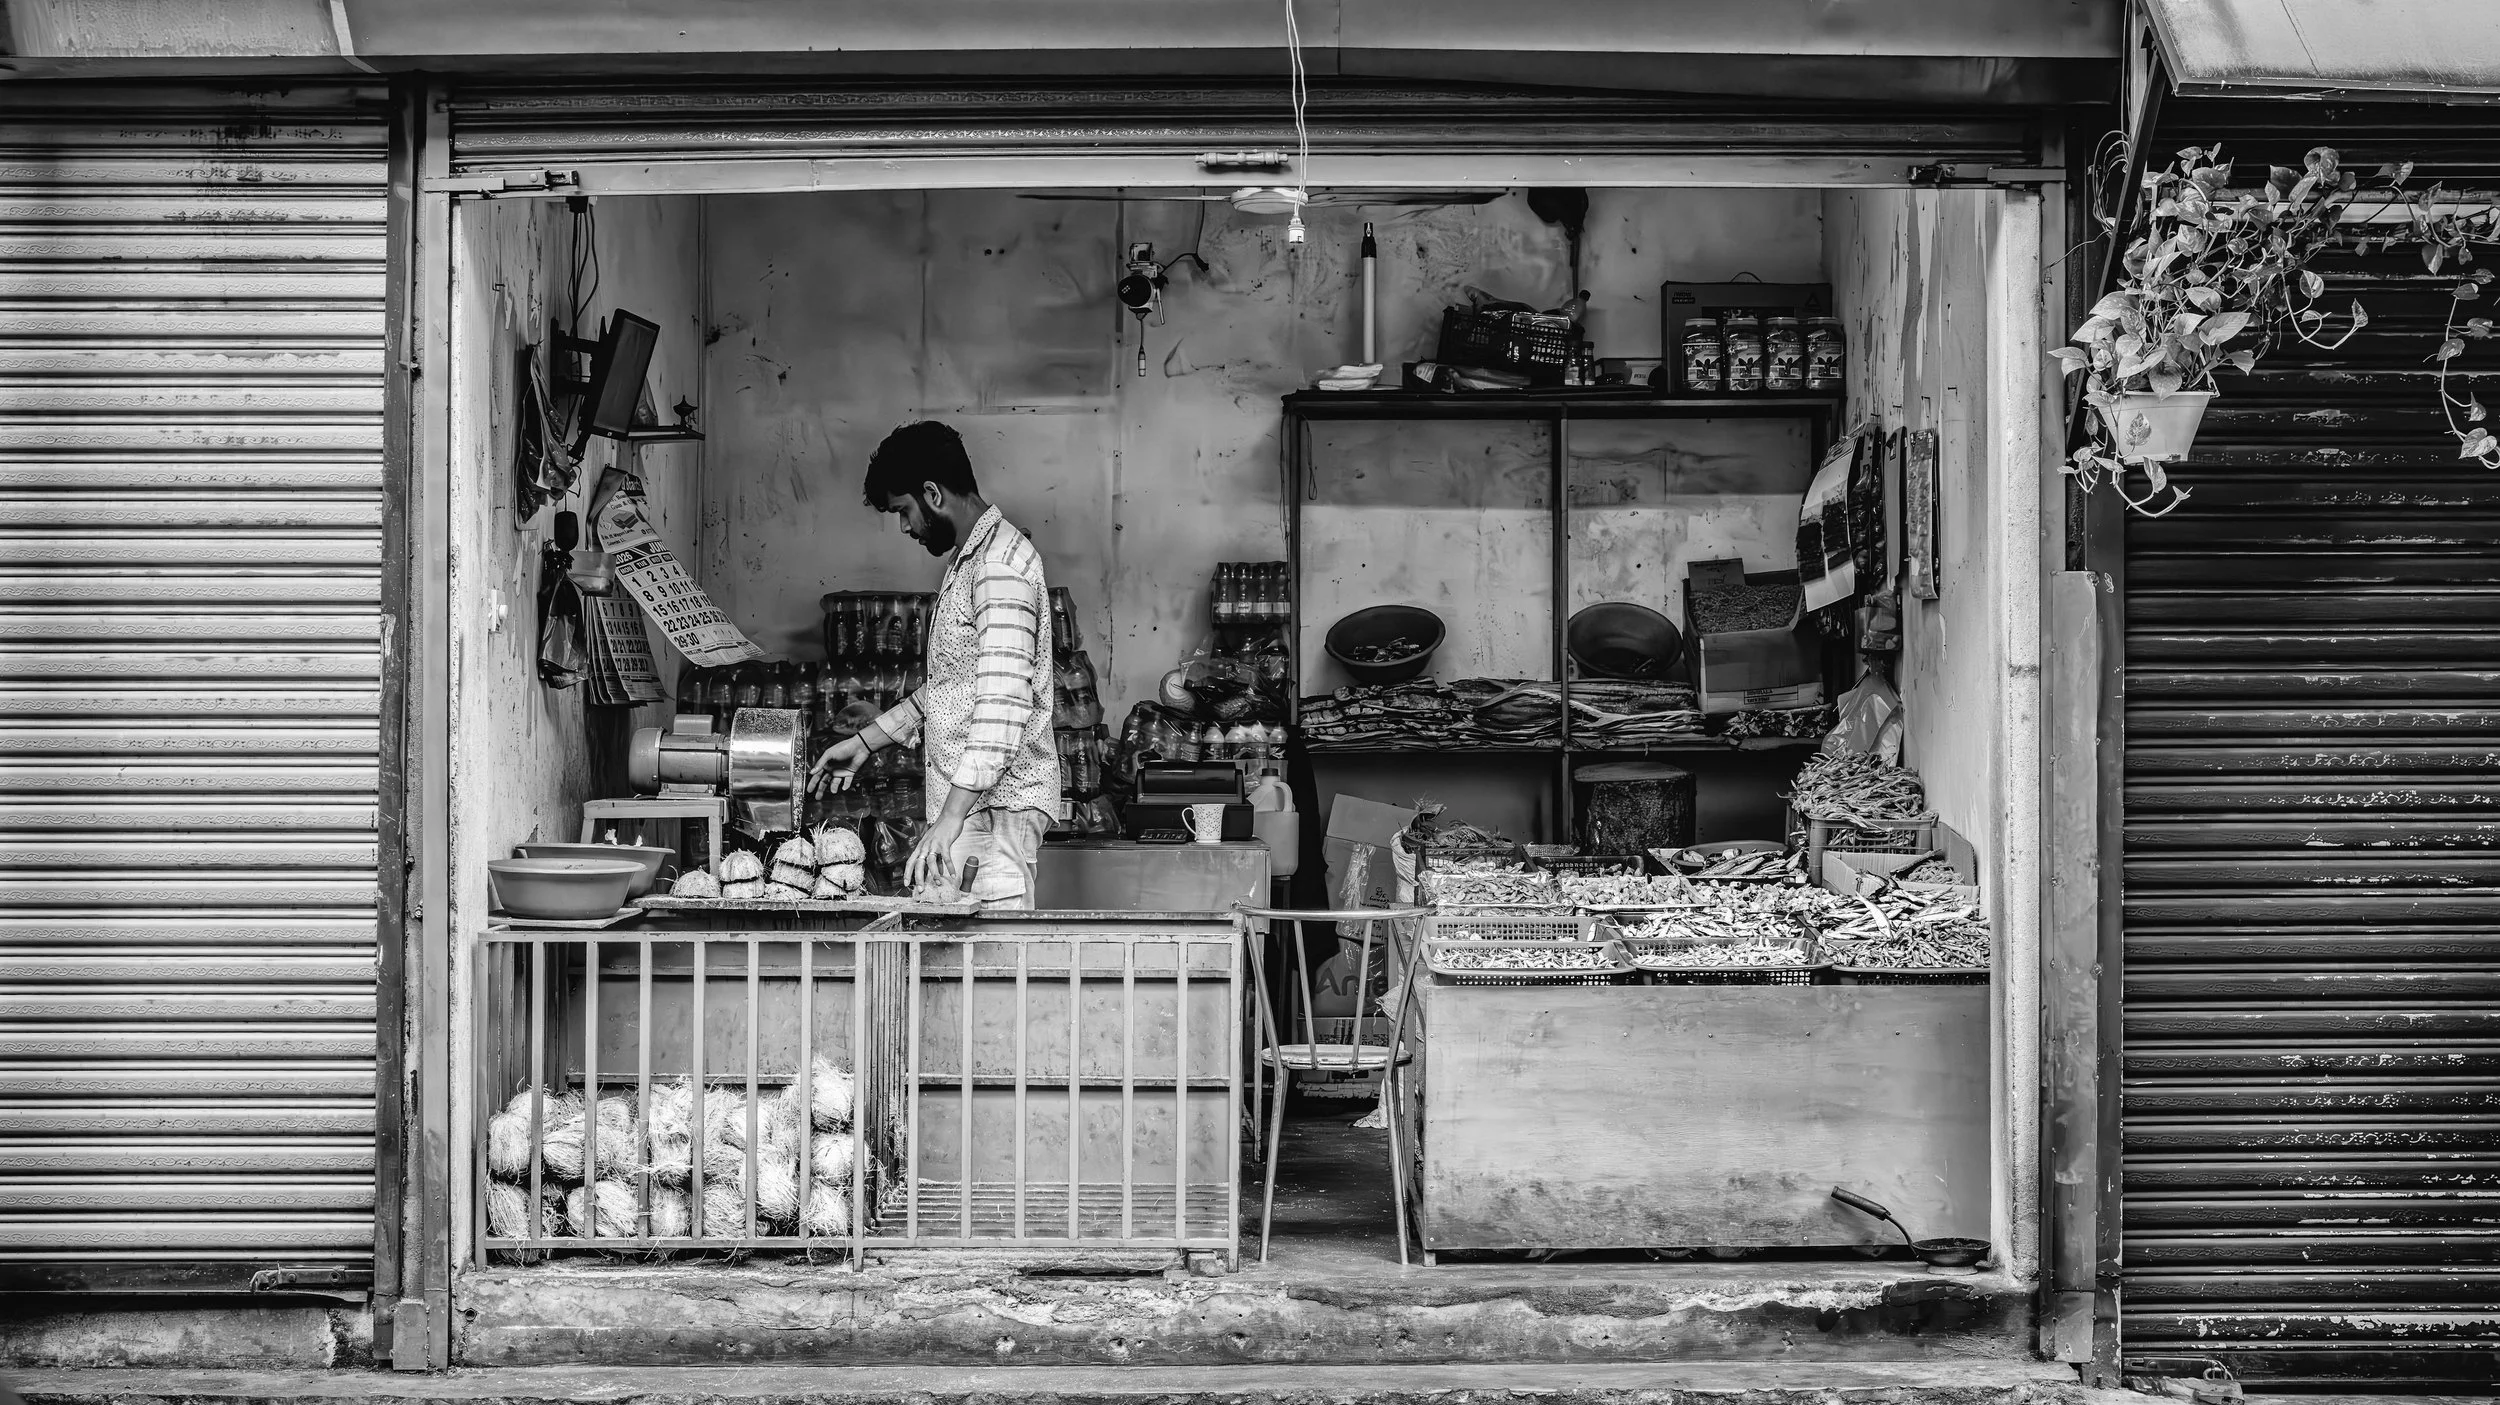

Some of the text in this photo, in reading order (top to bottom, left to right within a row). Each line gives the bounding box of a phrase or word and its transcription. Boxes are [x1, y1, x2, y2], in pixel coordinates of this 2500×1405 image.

[631, 565, 681, 588] 1 2 3 4
[642, 590, 655, 602] 8
[657, 585, 668, 598] 9
[668, 582, 682, 595] 10
[679, 580, 692, 593] 11
[610, 602, 616, 616] 7
[652, 604, 668, 618] 15
[666, 600, 680, 614] 16
[678, 598, 691, 611] 17
[690, 595, 702, 609] 18
[613, 621, 622, 635] 14
[621, 621, 630, 636] 15
[663, 619, 679, 633] 22
[676, 616, 690, 630] 23
[688, 614, 701, 627] 24
[699, 611, 713, 624] 25
[673, 634, 688, 648] 29
[686, 632, 700, 646] 30
